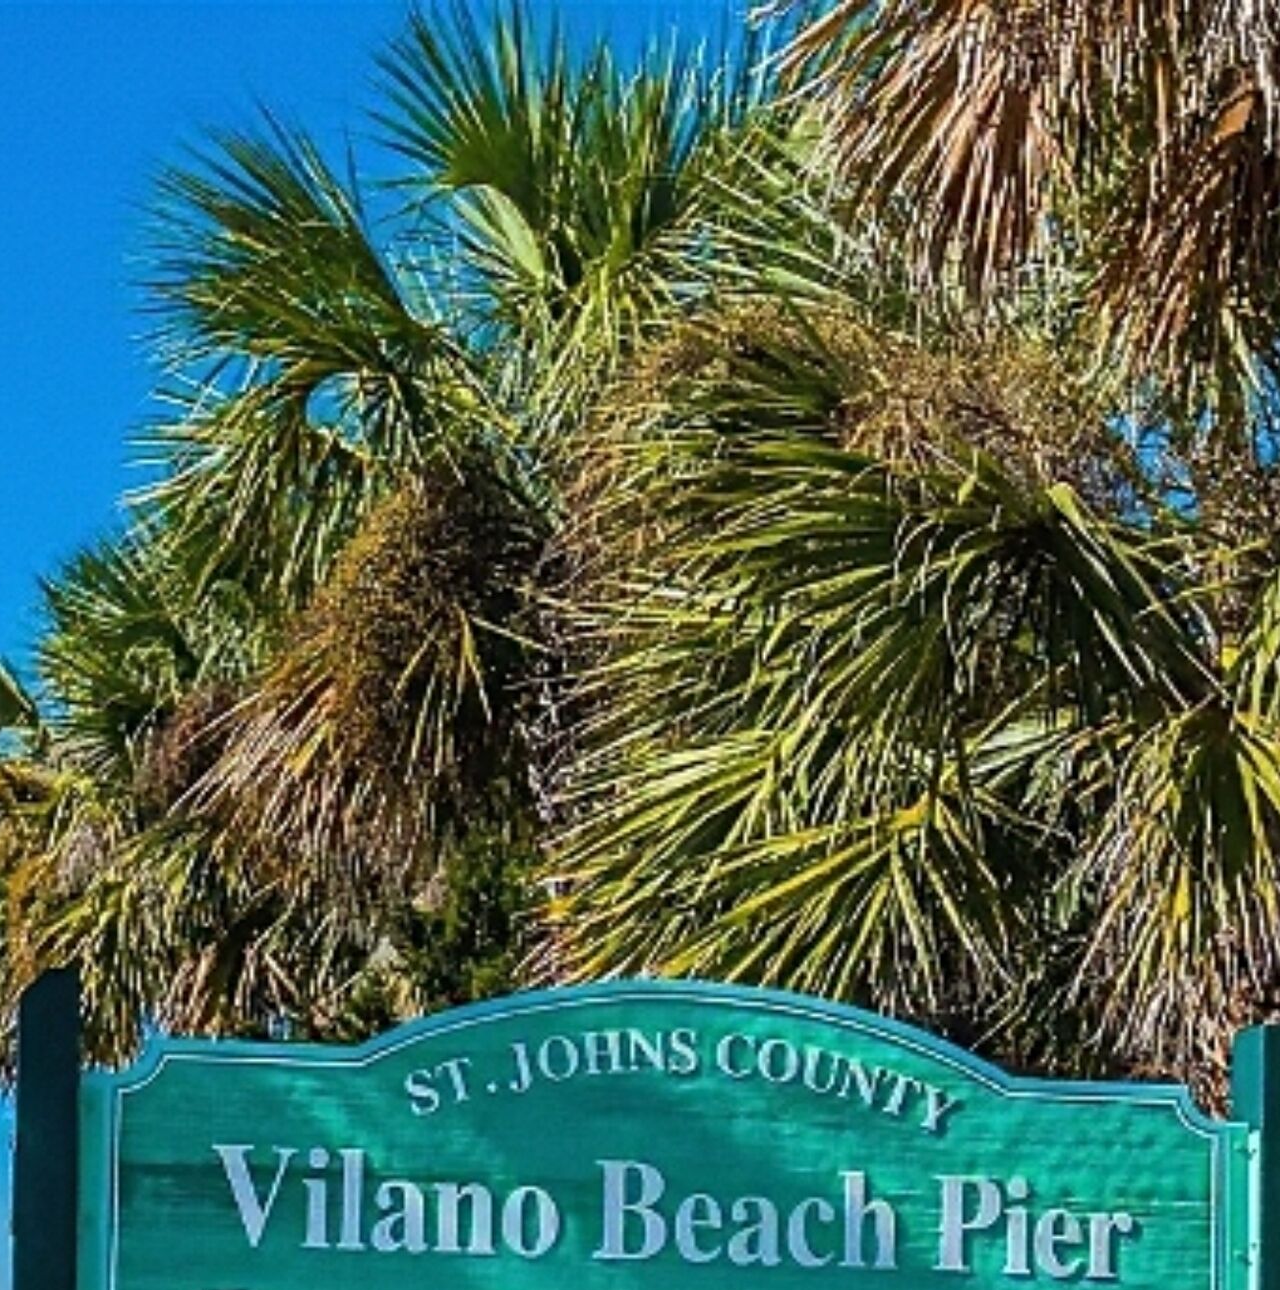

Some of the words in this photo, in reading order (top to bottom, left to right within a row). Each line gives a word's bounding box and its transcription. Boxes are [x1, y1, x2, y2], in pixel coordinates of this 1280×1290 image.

[403, 1057, 498, 1117] ST.
[510, 1027, 699, 1093] JOHNS
[715, 1032, 960, 1132] COUNTY
[212, 1143, 561, 1259] Vilano
[592, 1160, 897, 1269] Beach
[932, 1173, 1139, 1281] Pier
